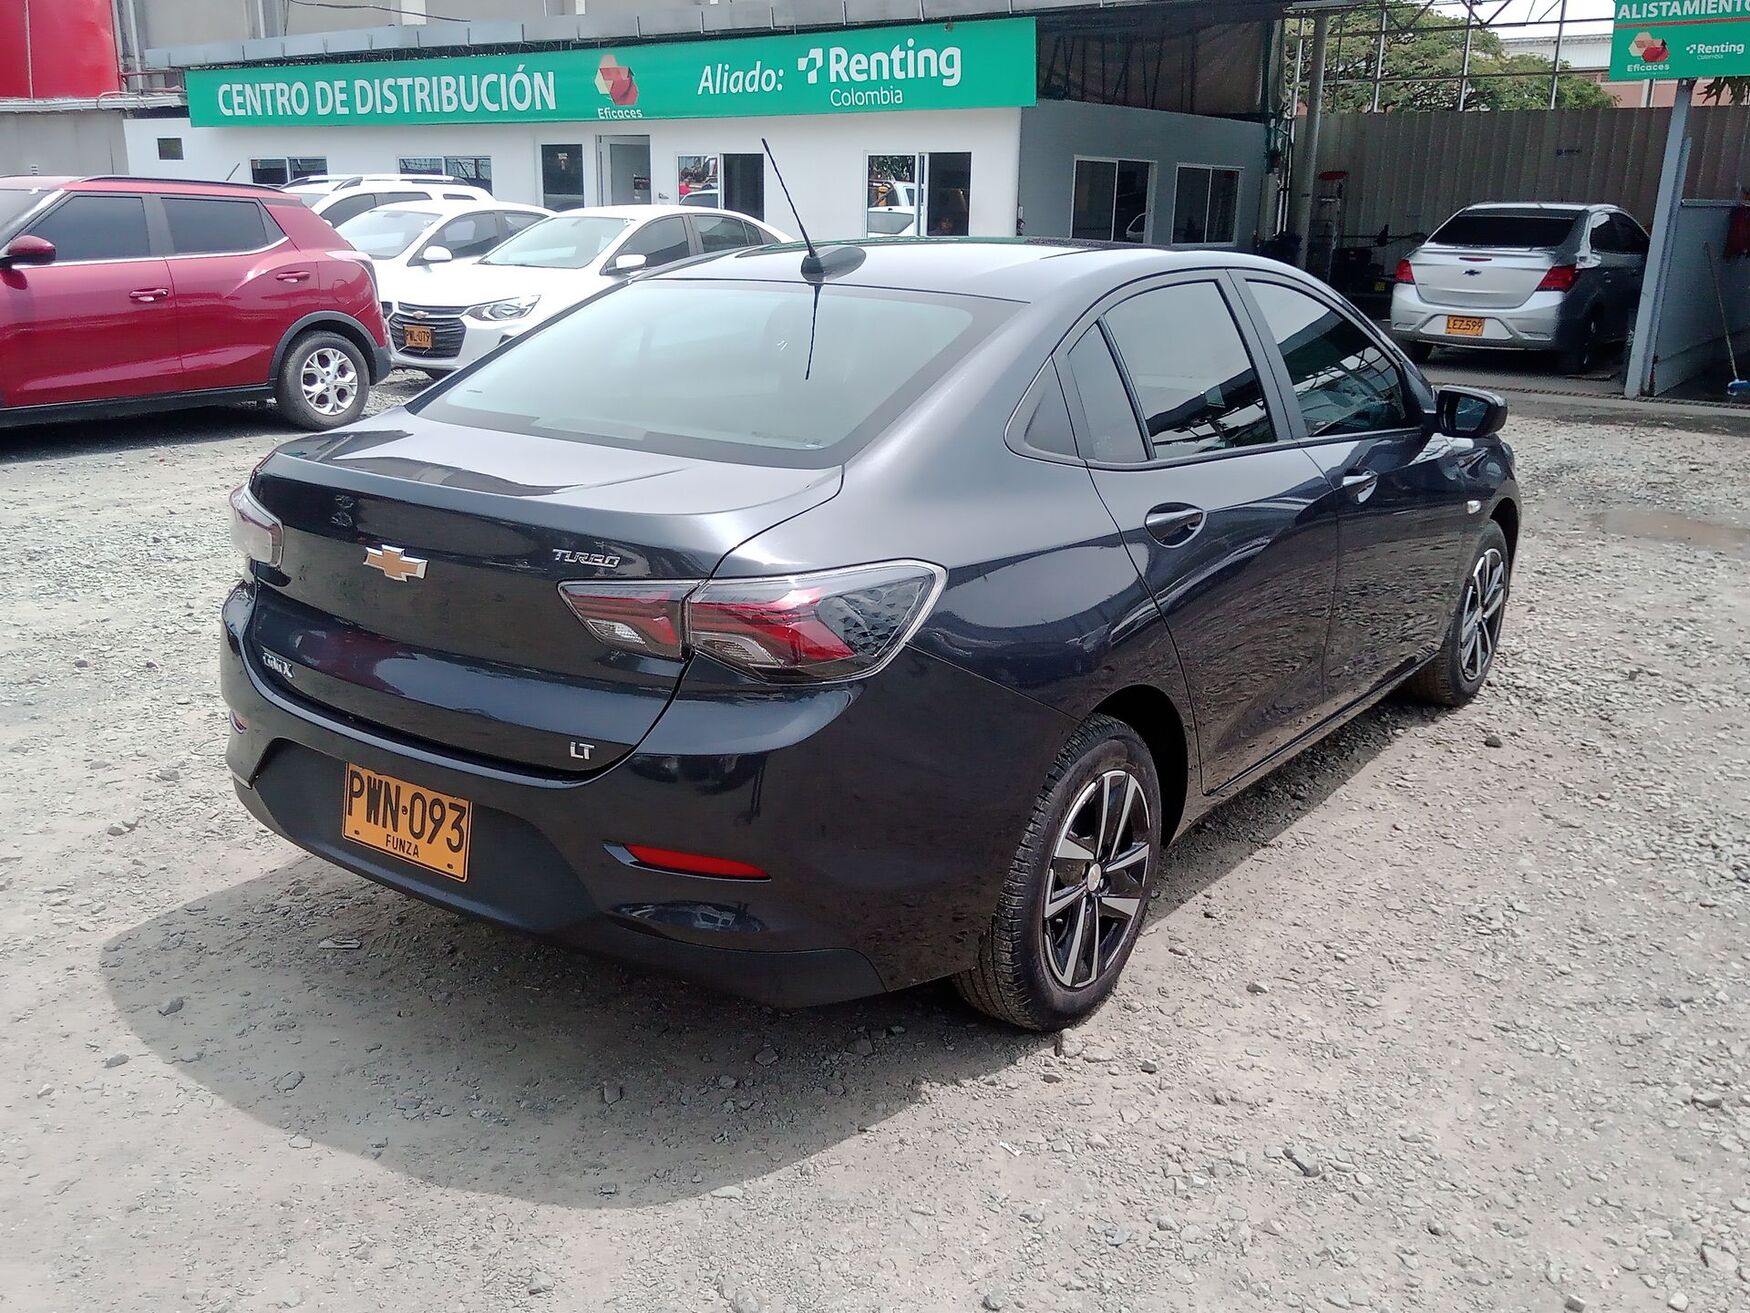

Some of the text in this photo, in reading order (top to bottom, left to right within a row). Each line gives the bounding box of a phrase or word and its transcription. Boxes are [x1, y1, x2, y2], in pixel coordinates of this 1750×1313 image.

[1697, 41, 1745, 55] Renting
[829, 38, 962, 87] Renting
[1627, 63, 1670, 72] Eficaces
[698, 61, 784, 95] Aliado:
[218, 64, 557, 116] CENTRO DE DISTRIBUCIÓN
[830, 85, 903, 107] Colombia
[597, 106, 643, 119] Eficaces
[552, 548, 621, 568] TURBO
[570, 741, 595, 760] LT
[385, 834, 420, 858] FUNZA
